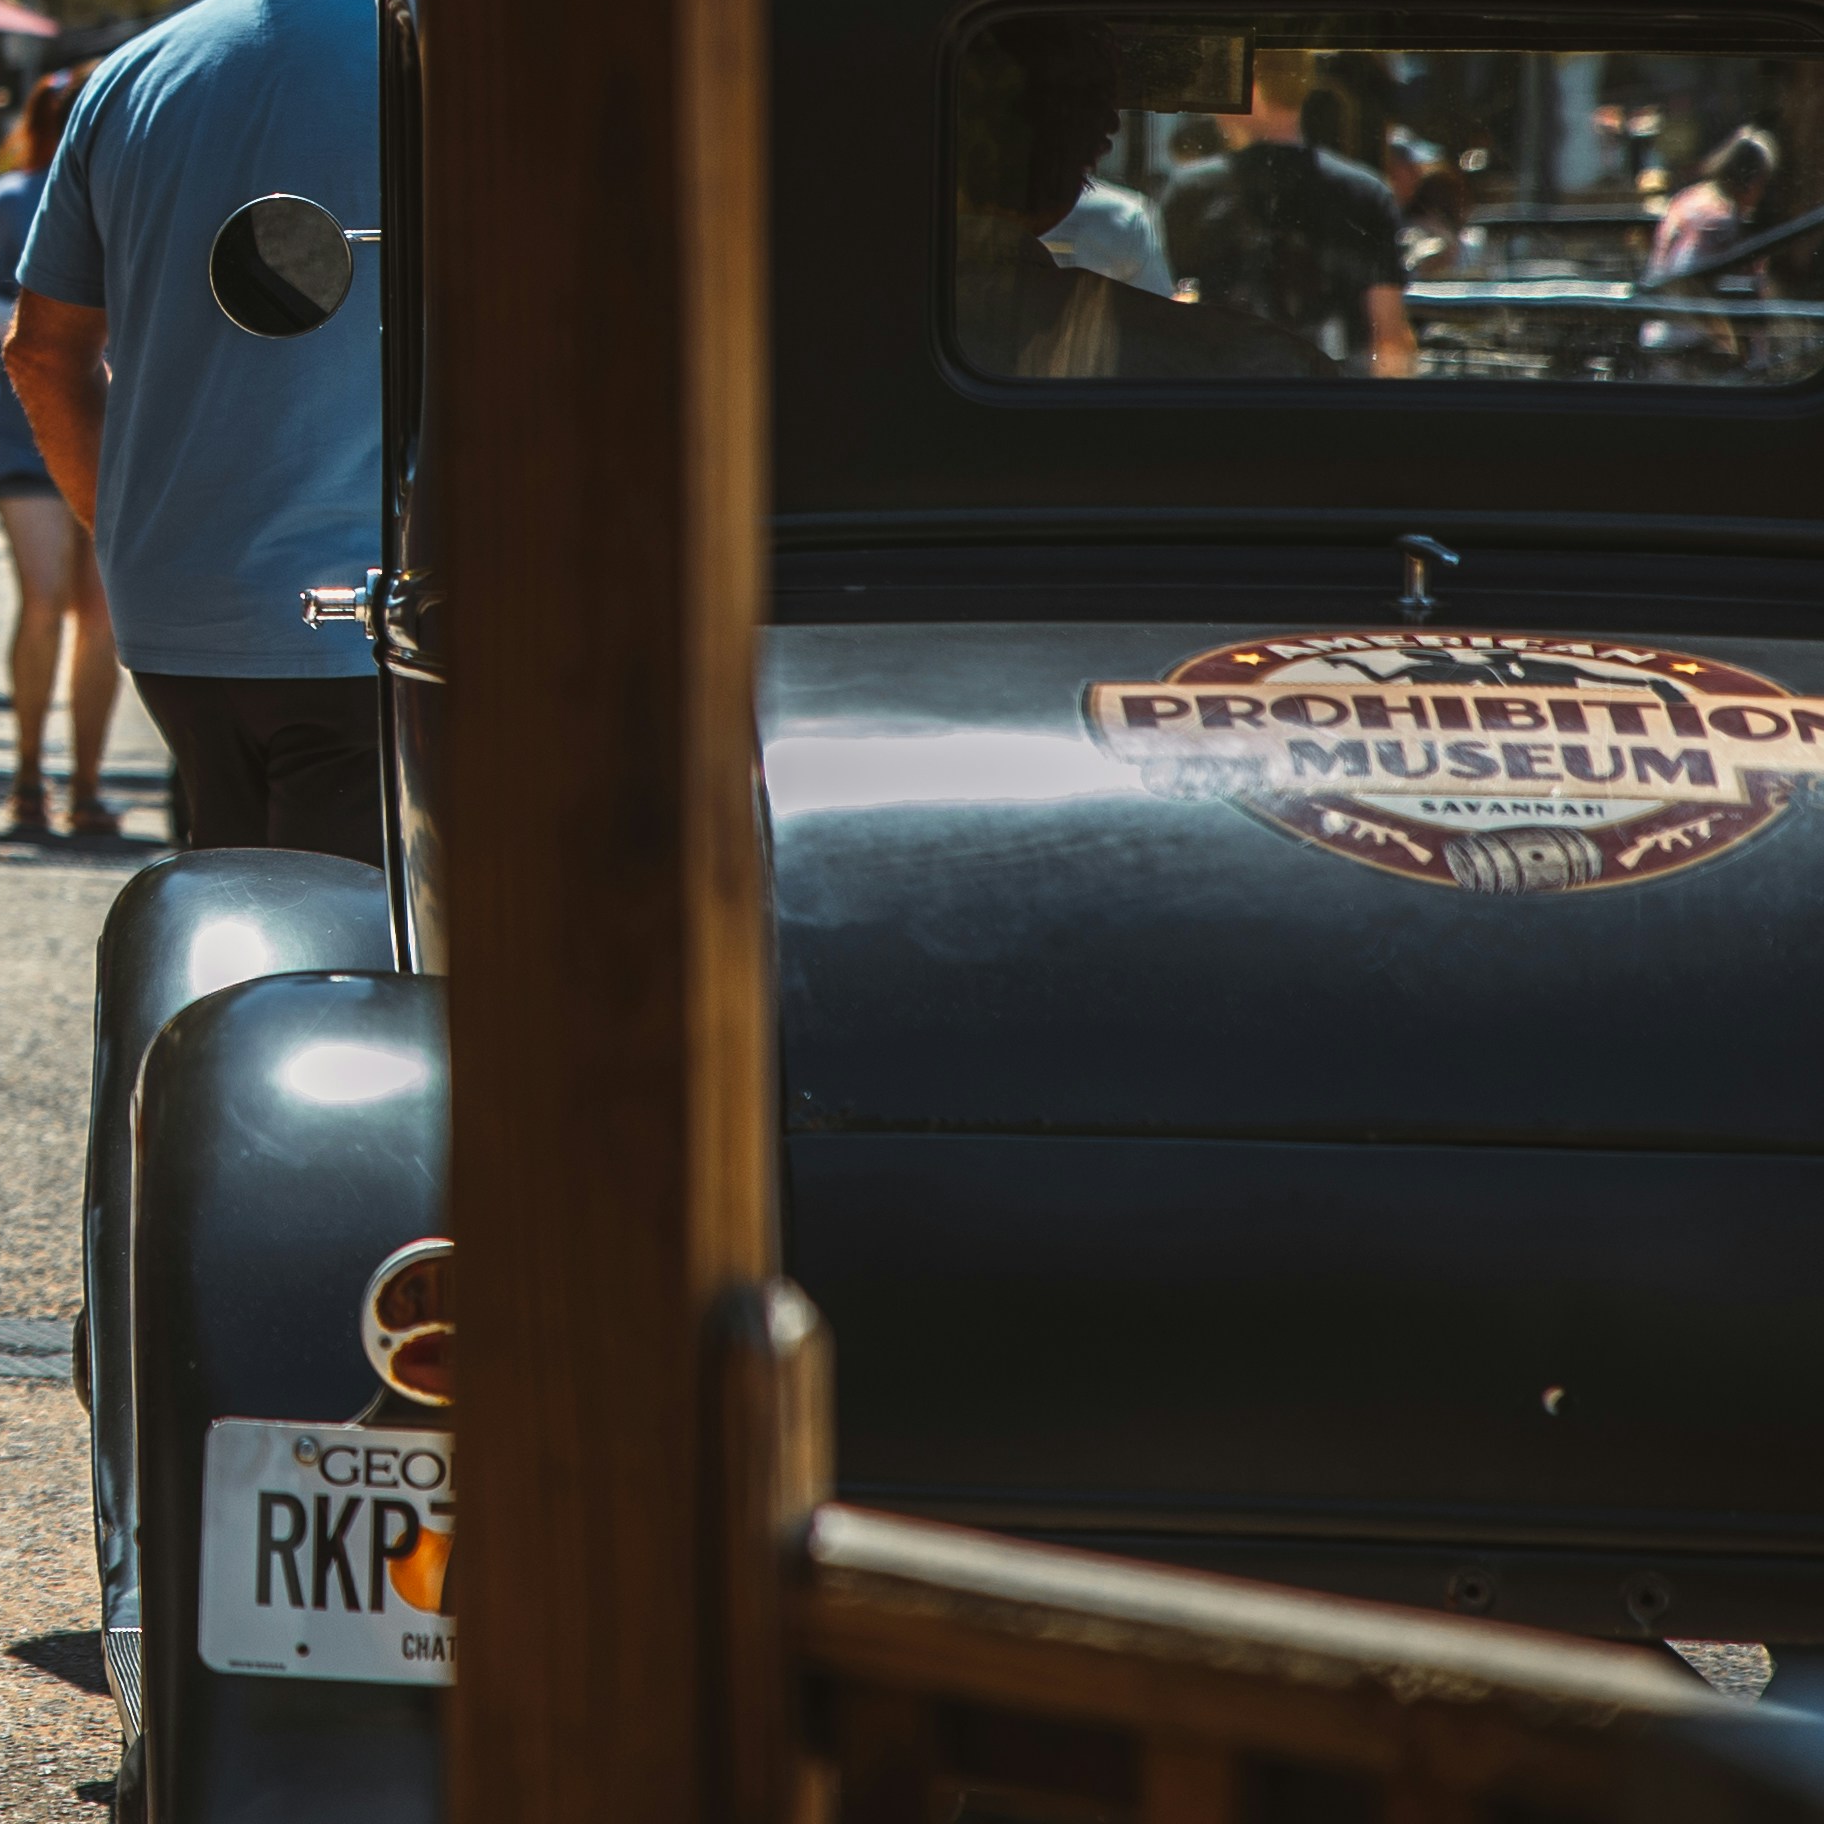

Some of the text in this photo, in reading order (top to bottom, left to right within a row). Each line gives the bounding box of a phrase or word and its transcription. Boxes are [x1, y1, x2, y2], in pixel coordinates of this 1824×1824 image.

[1266, 634, 1657, 664] AMERICAN
[1289, 739, 1720, 788] MUSEUM
[1418, 799, 1604, 819] SAVANNAH
[318, 1444, 457, 1490] GEO
